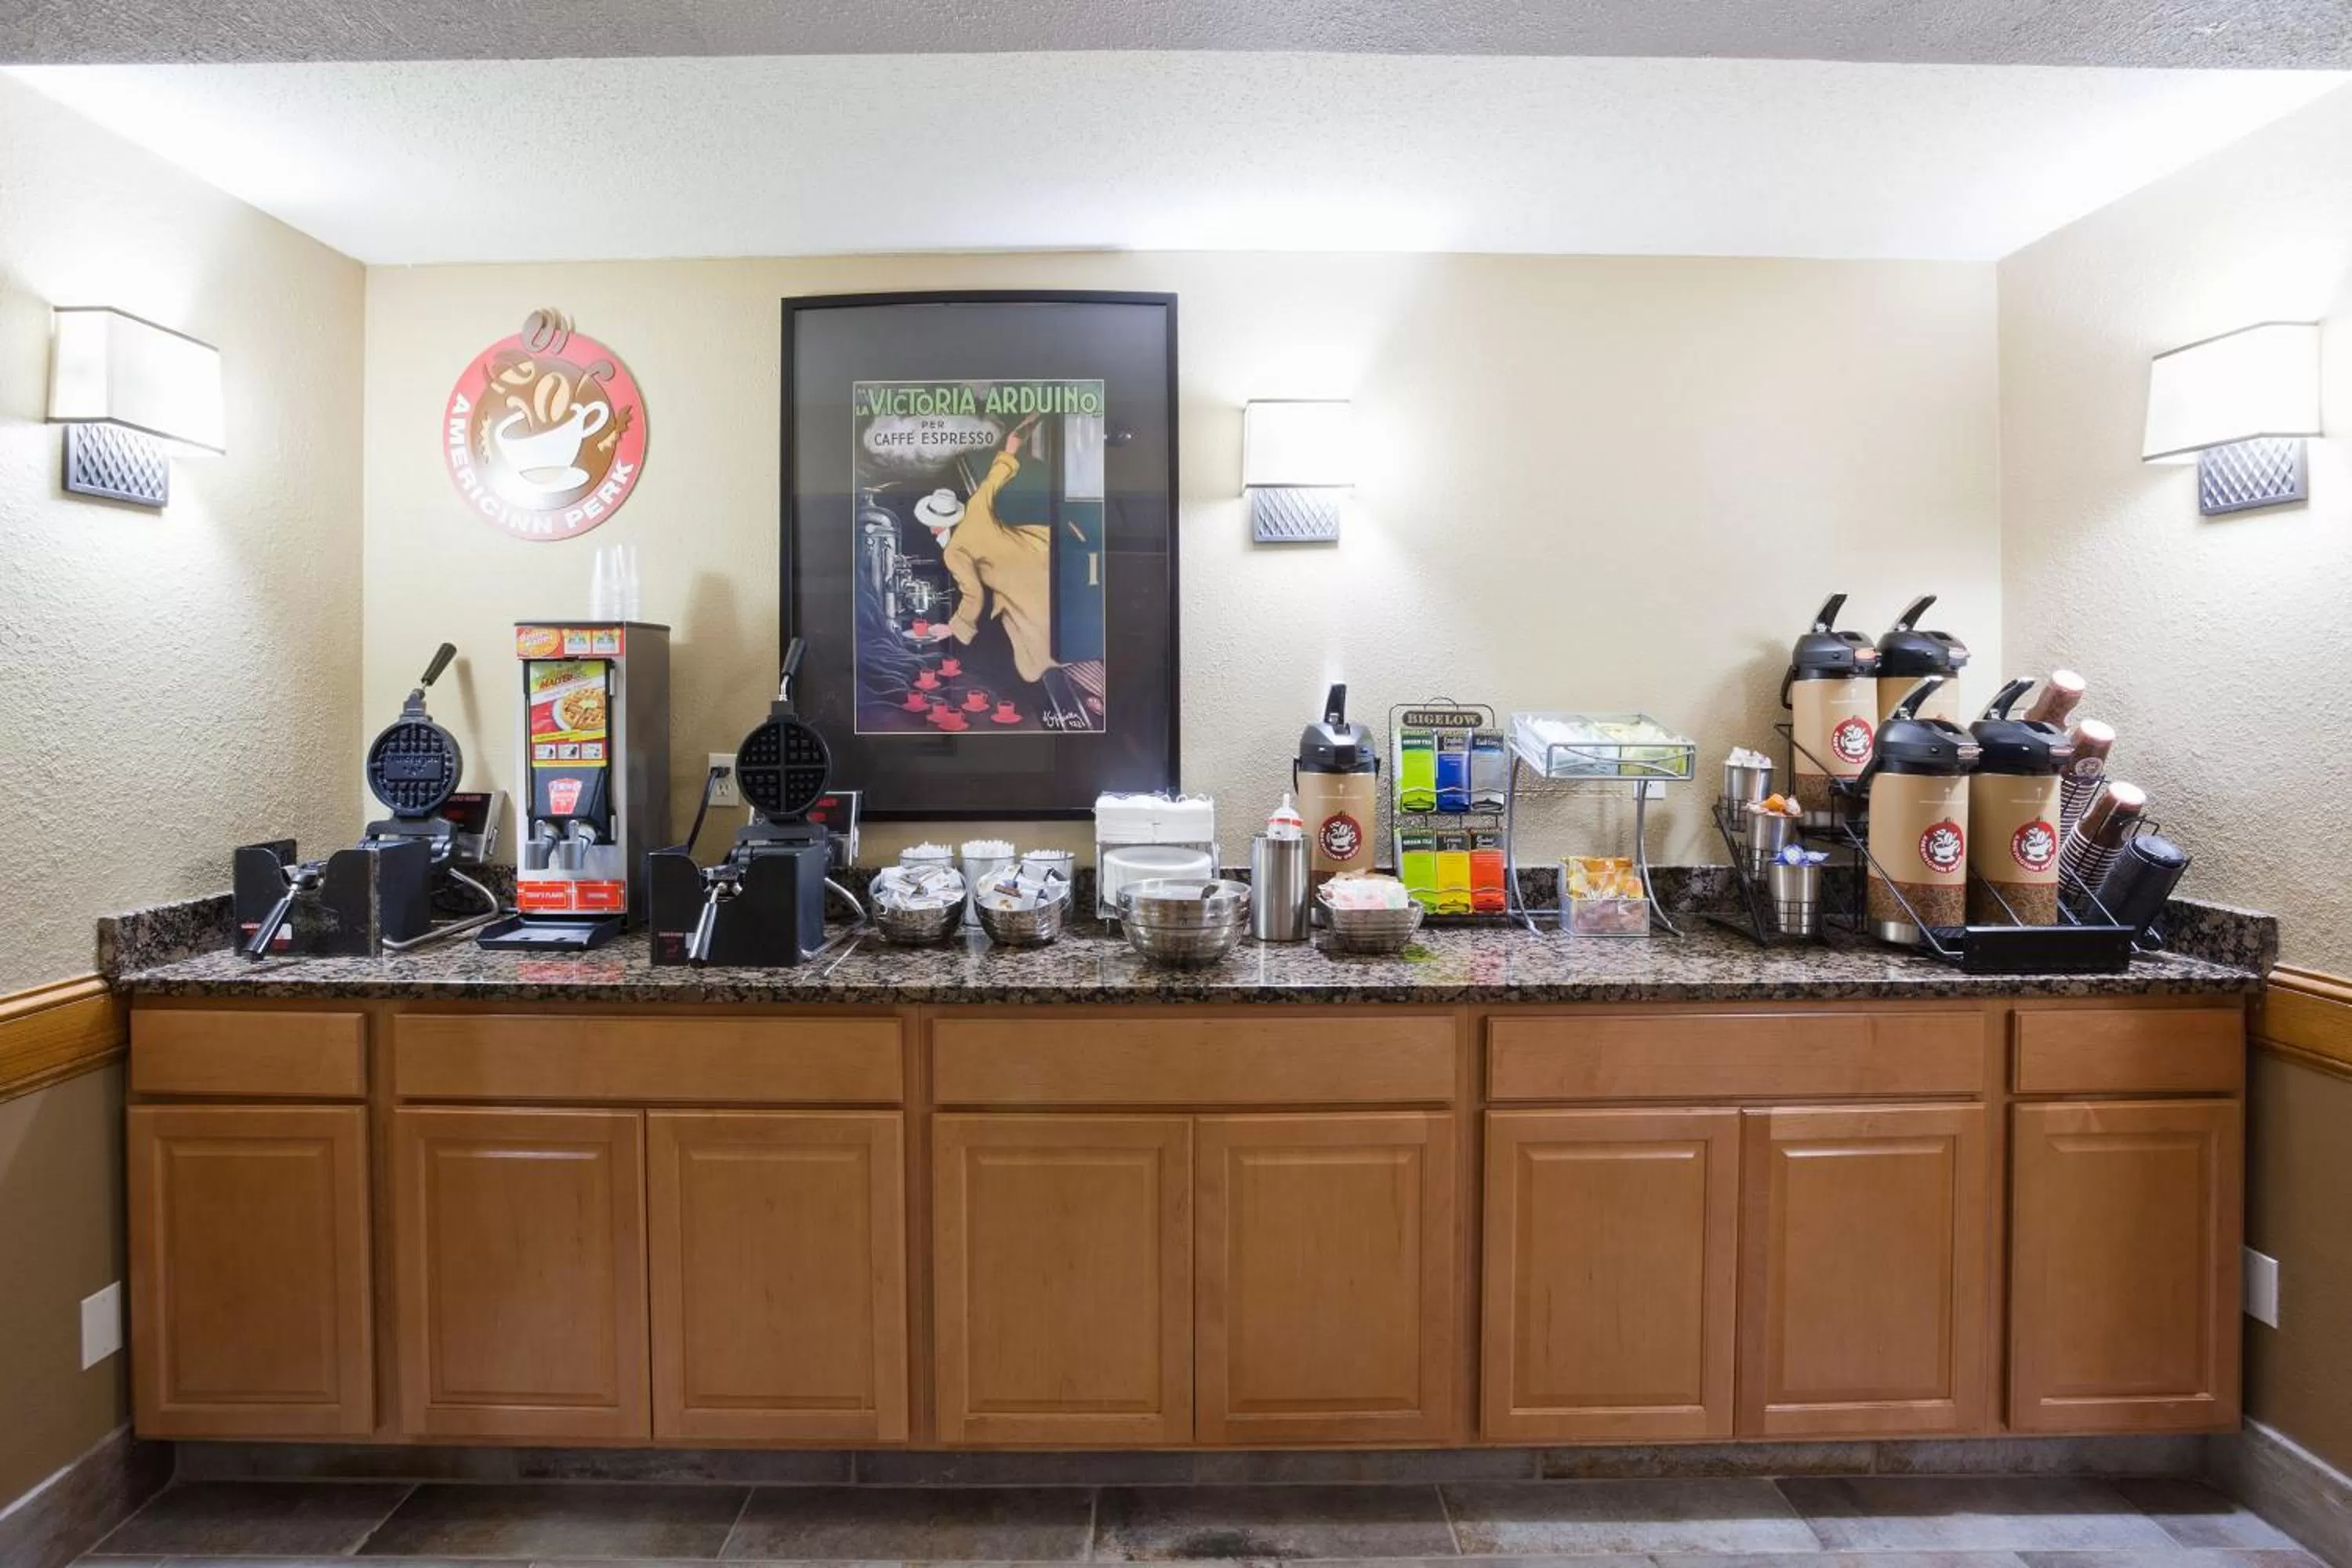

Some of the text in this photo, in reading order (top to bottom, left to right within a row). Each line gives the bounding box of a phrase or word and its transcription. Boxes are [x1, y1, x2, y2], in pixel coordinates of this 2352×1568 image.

[868, 387, 976, 416] VICTORIA
[985, 386, 1098, 414] ARDUINO
[921, 420, 945, 429] PER
[921, 432, 994, 445] ESPRESSO
[564, 458, 633, 528] PERK
[1406, 713, 1477, 724] BIGELOW
